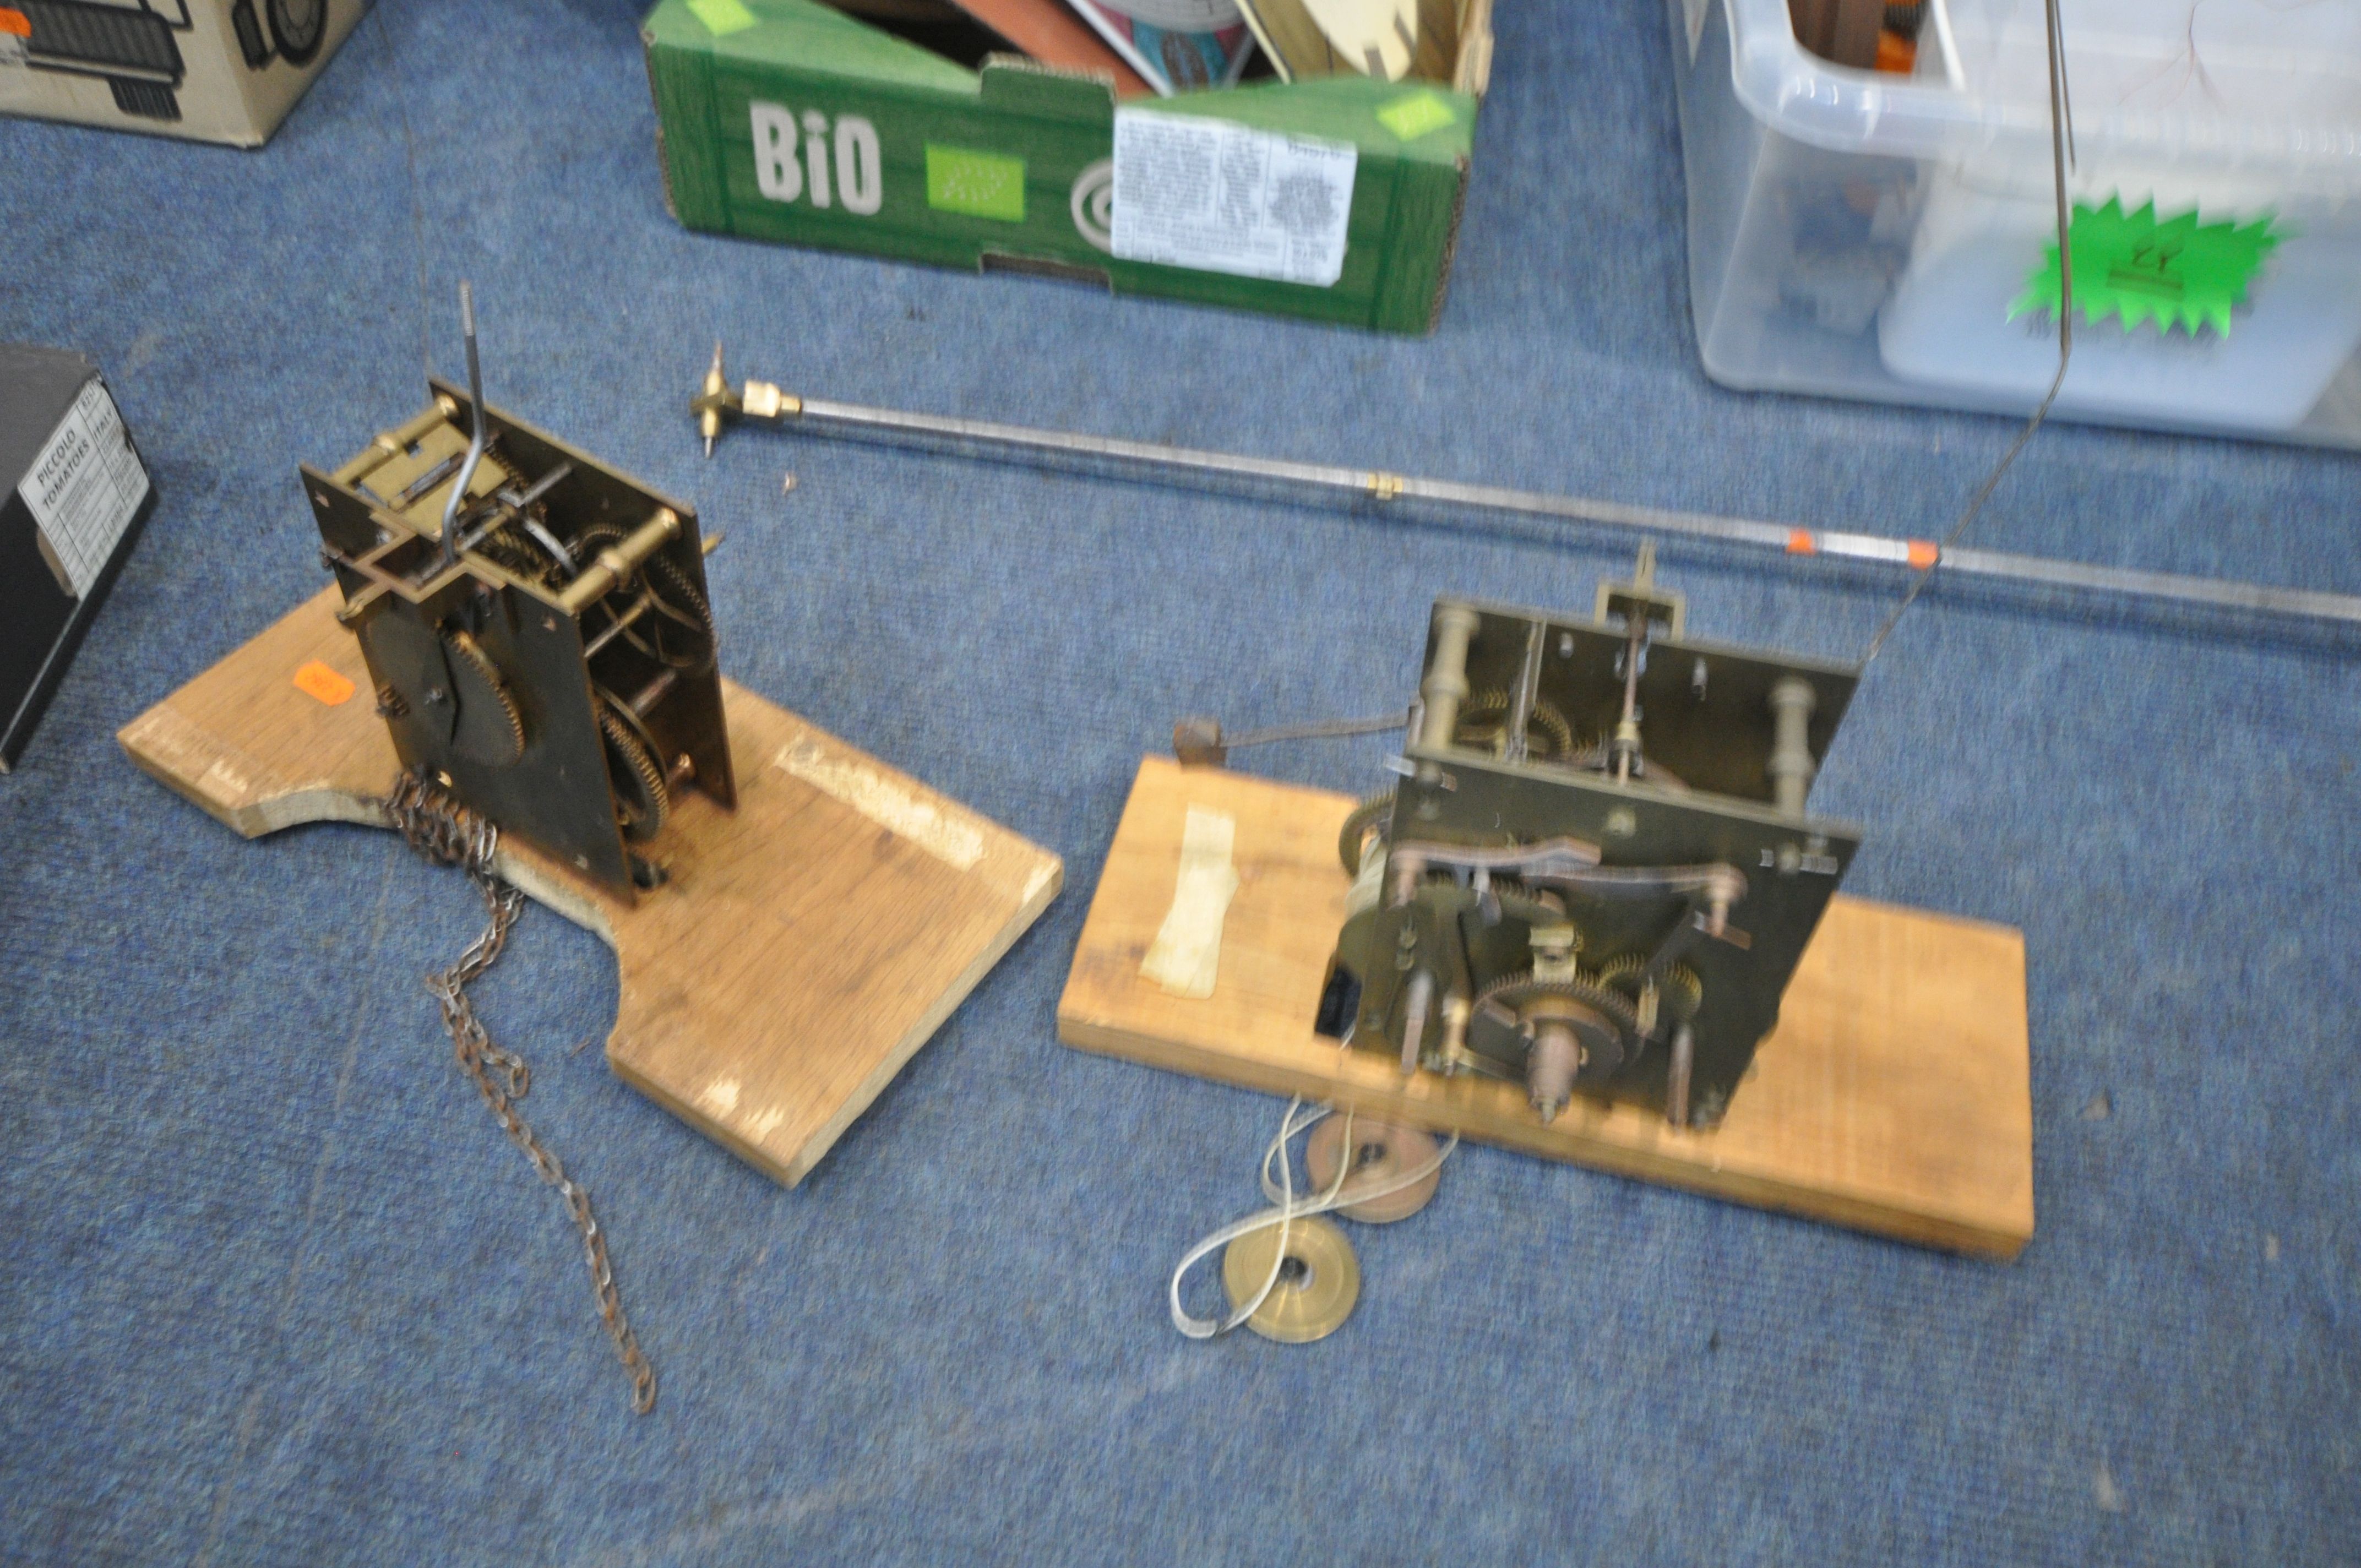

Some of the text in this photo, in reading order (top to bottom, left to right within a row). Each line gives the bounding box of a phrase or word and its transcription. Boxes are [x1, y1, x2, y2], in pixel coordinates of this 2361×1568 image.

[93, 406, 113, 440] ITALY
[37, 428, 75, 486] PICCOLO
[43, 440, 90, 509] TOMATOES
